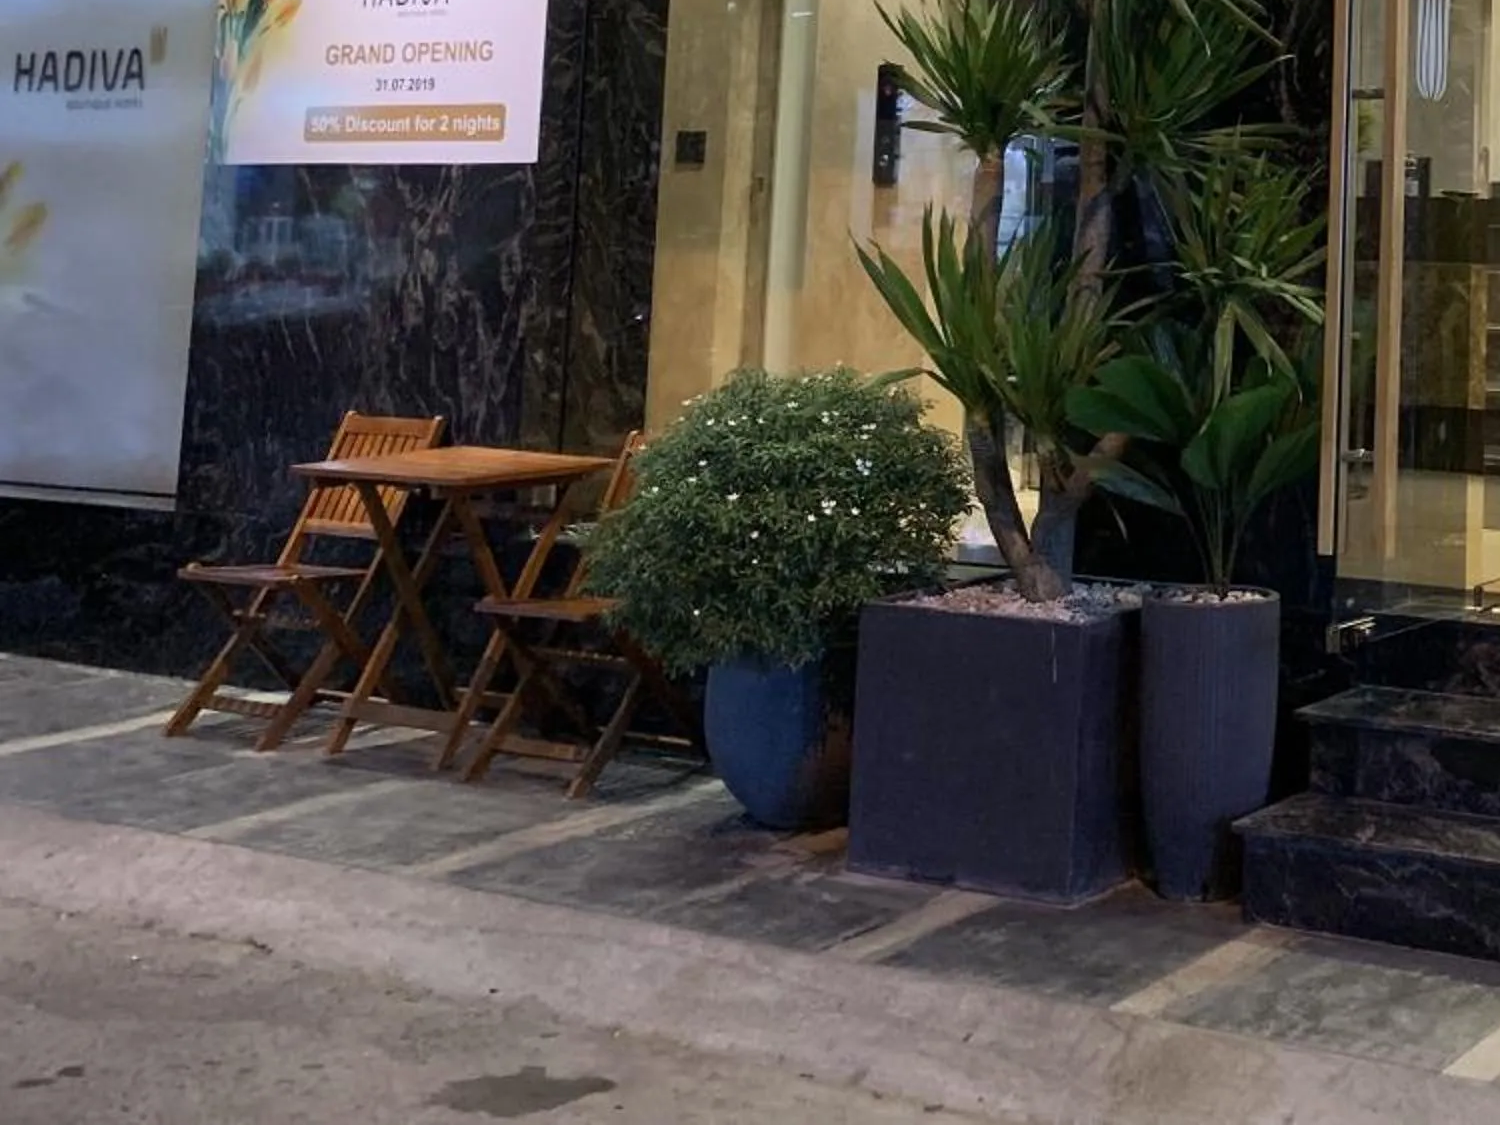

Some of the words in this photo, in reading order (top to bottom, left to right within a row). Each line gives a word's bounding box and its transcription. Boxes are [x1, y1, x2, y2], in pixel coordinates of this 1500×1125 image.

[325, 43, 396, 66] GRAND
[401, 40, 494, 64] OPENING
[13, 47, 145, 93] HADIVA
[375, 77, 436, 92] 31.07.2019
[345, 115, 410, 133] Discount
[415, 115, 435, 132] for
[438, 115, 449, 132] 2
[453, 113, 501, 136] nights
